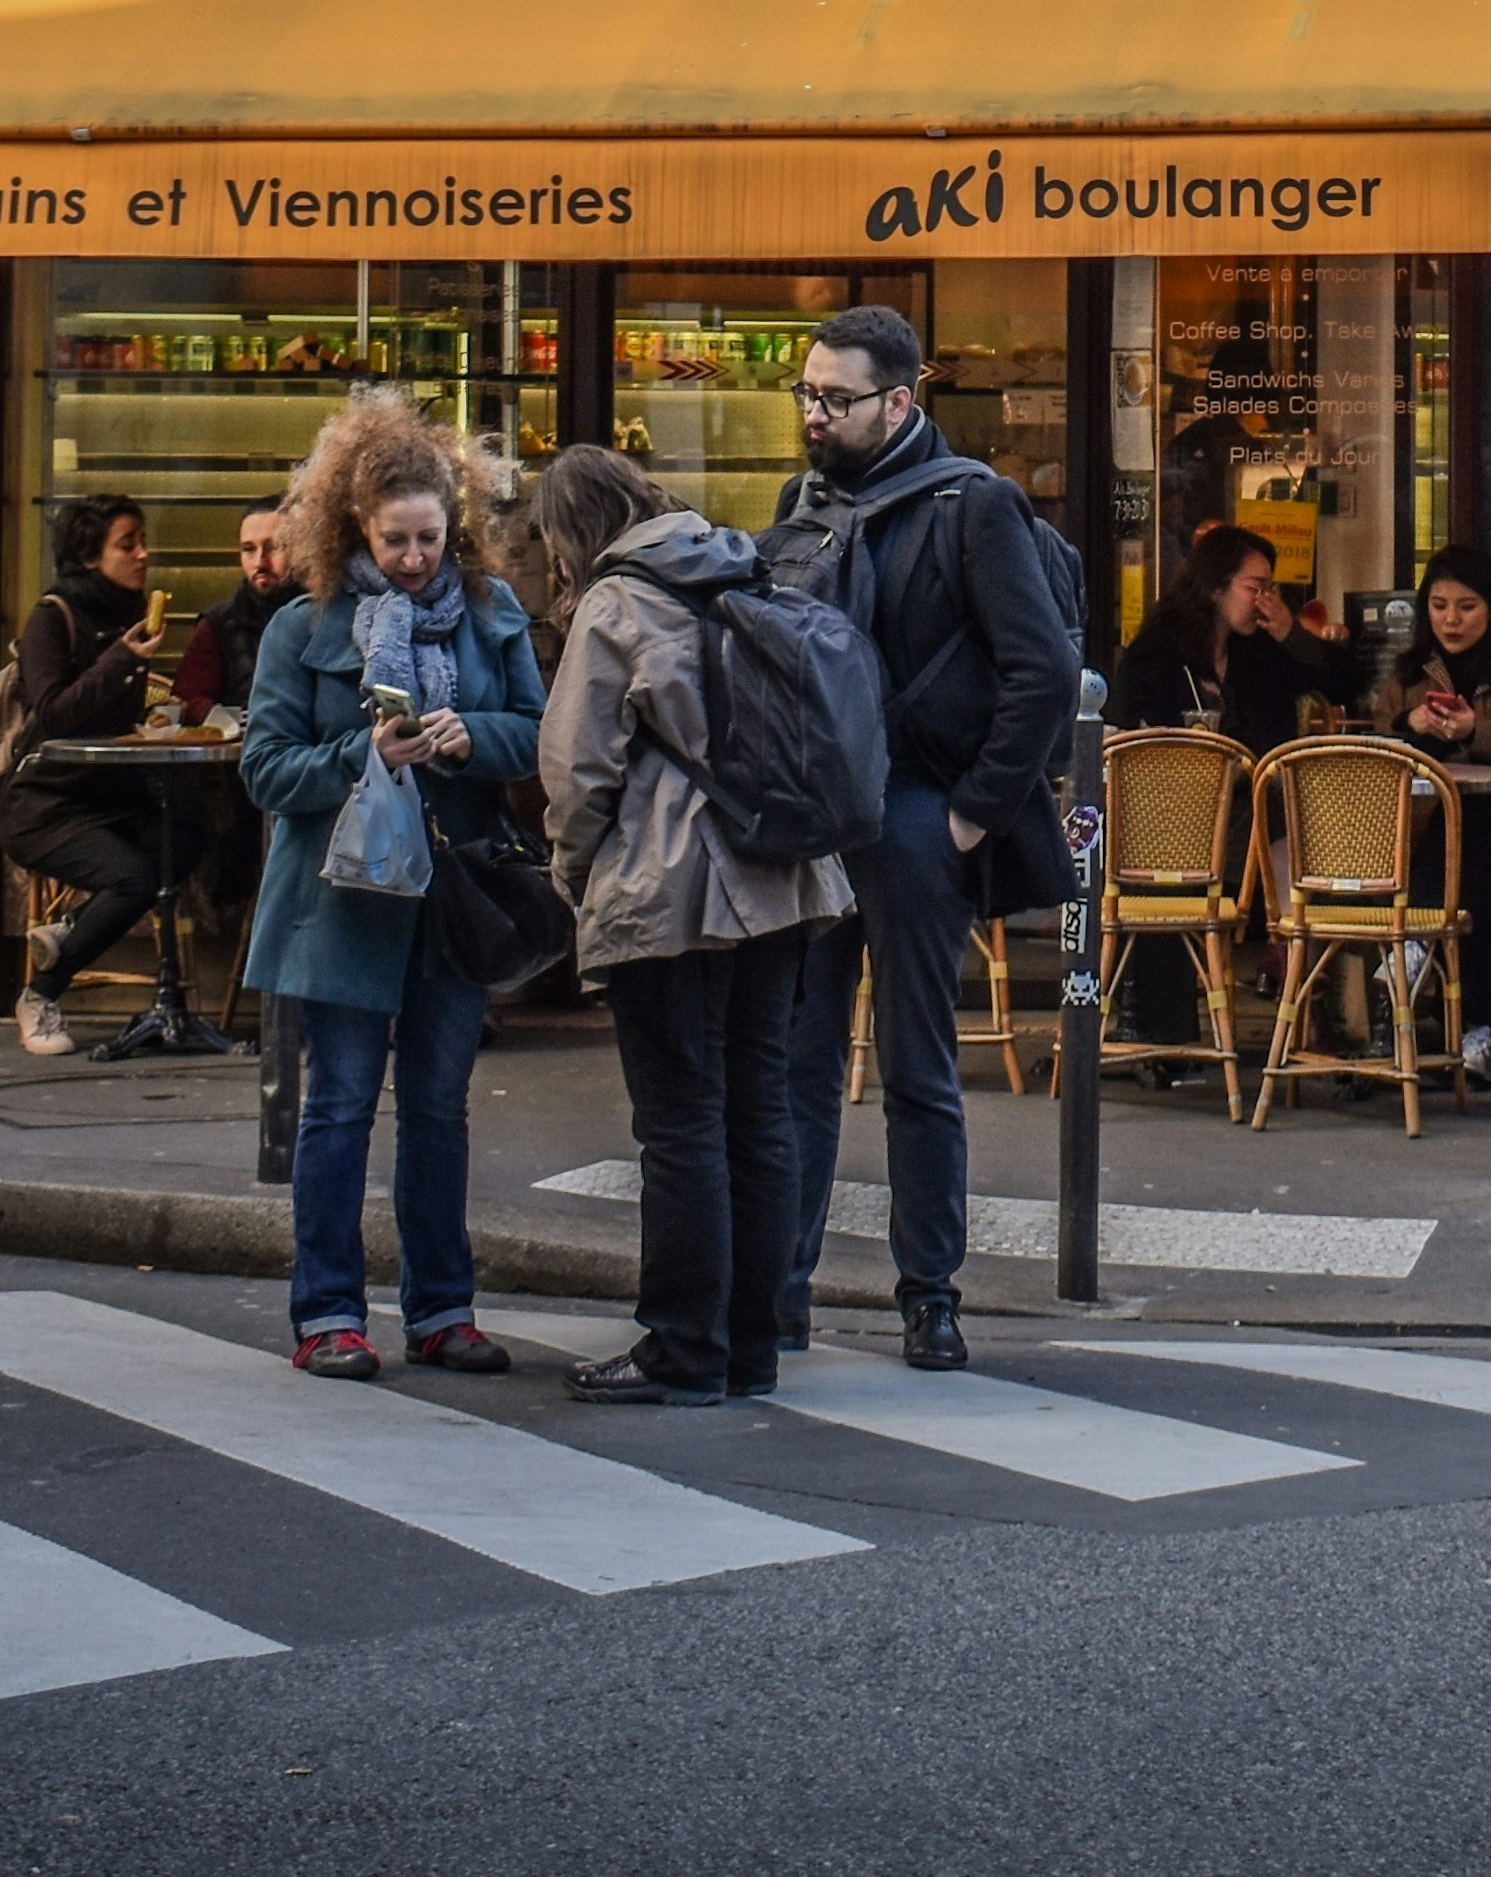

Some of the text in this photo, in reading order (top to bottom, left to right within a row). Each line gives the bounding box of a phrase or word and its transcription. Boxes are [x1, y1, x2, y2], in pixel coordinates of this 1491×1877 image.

[126, 179, 187, 227] et
[224, 173, 634, 228] Viennoiseries
[1033, 163, 1382, 230] boulanger
[1207, 264, 1271, 282] Vente
[1169, 321, 1241, 340] Coffee
[1324, 321, 1378, 340] Take
[1208, 371, 1325, 389] Sandwichs
[1193, 396, 1280, 415] Salades
[1229, 447, 1379, 466] Plats du Jour
